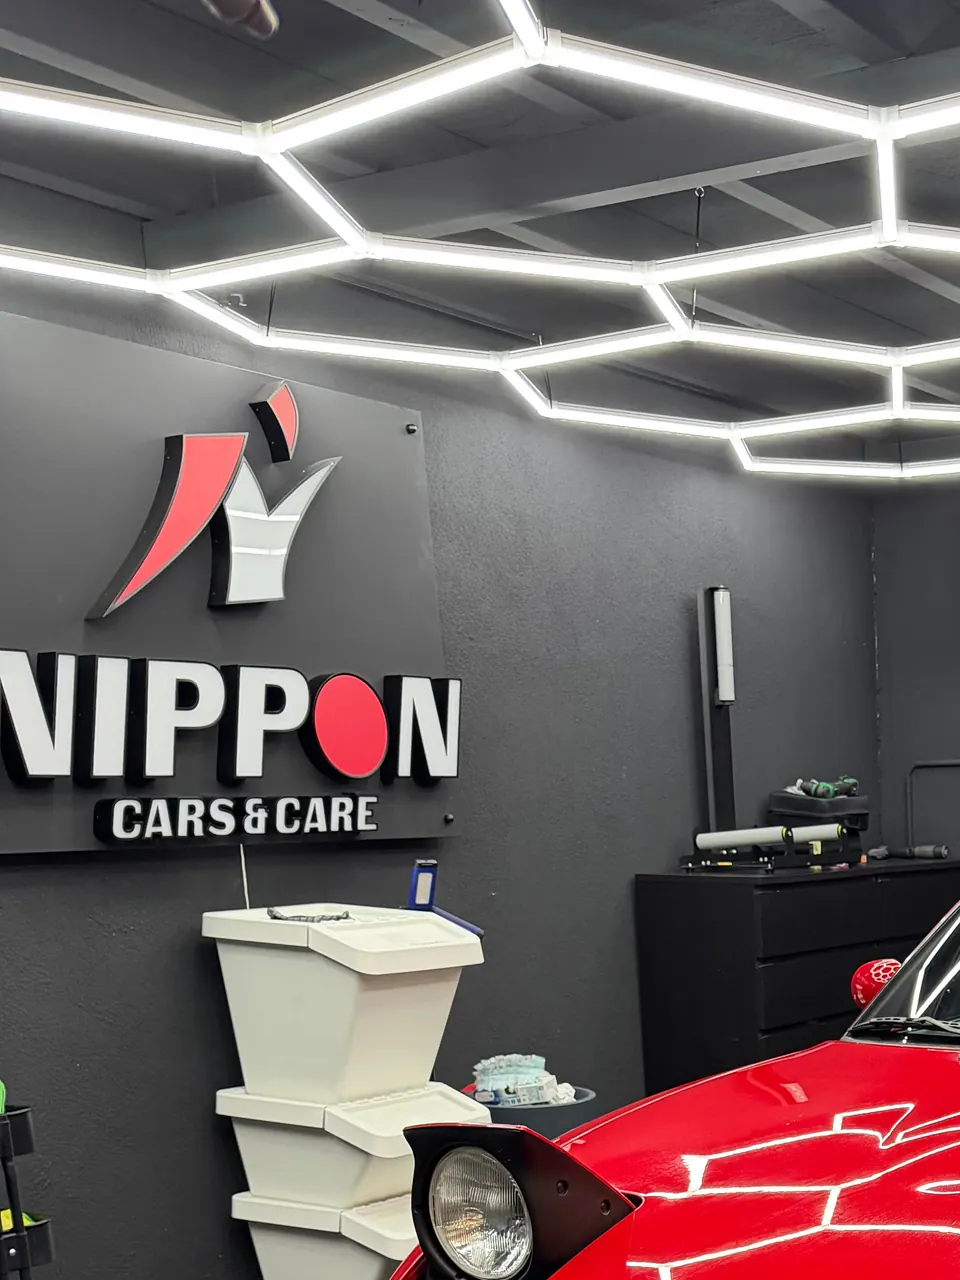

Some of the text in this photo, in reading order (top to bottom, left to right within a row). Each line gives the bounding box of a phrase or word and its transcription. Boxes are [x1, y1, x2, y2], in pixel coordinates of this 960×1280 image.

[0, 648, 462, 779] NIPPON
[112, 795, 379, 839] CARS & CARE
